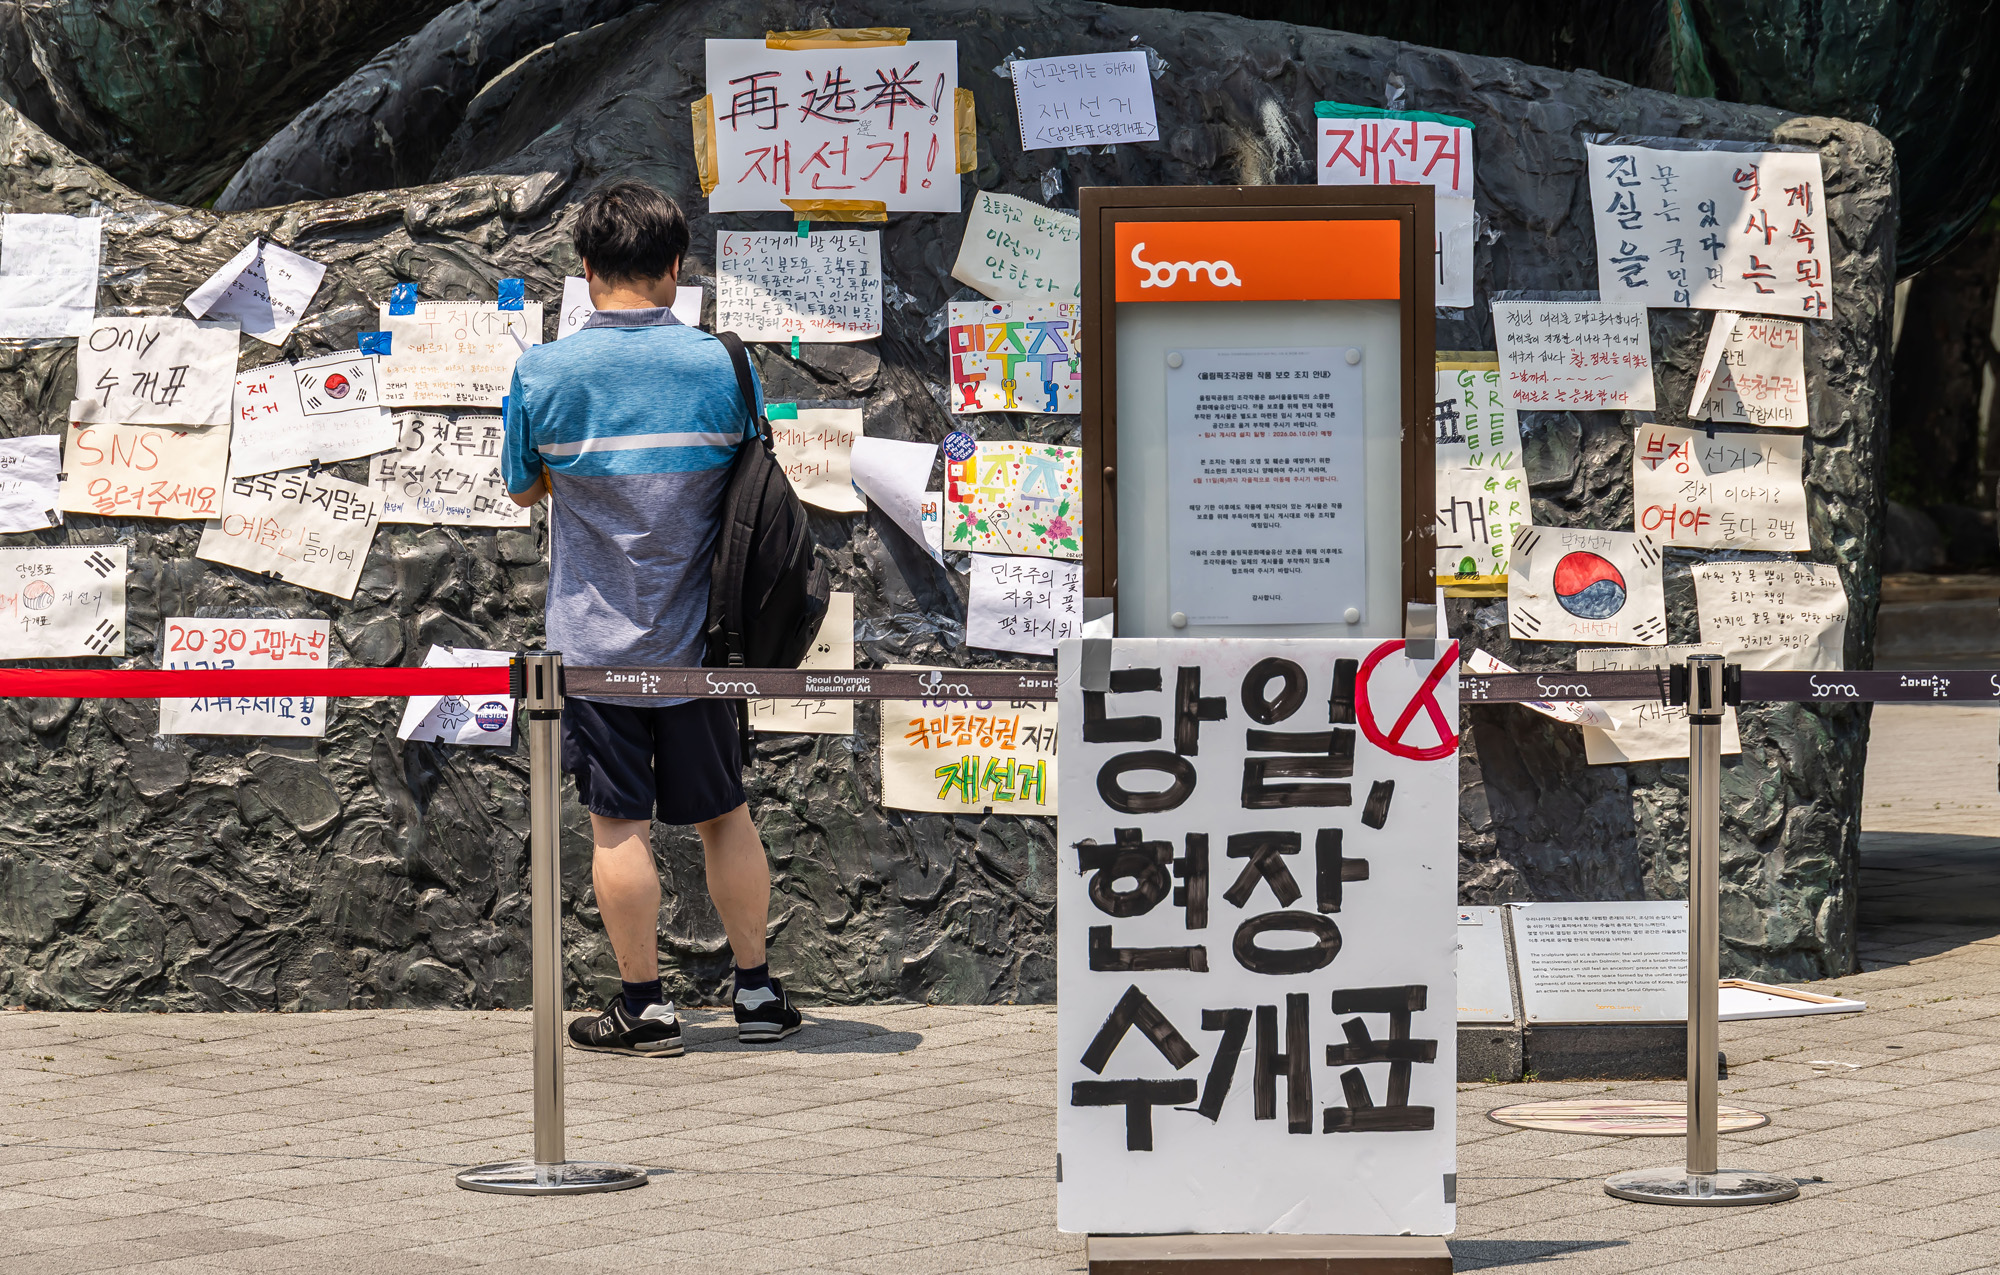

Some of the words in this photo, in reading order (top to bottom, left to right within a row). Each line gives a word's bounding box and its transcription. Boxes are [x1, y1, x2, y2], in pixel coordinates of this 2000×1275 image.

[1024, 62, 1097, 88] 선관위는
[1103, 61, 1136, 77] 해체
[719, 60, 945, 132] 再选举!
[1038, 95, 1133, 119] 재선거
[737, 131, 940, 195] 재선거!
[1325, 121, 1461, 191] 재선거
[1605, 154, 1650, 289] 진실을
[1732, 163, 1778, 295] 역사는
[723, 234, 752, 257] 6.3
[754, 236, 799, 254] 선거에
[810, 235, 869, 254] 발생된
[1697, 198, 1726, 290] 있다면
[1783, 181, 1828, 318] 계속된다
[722, 258, 757, 272] 타인
[822, 256, 873, 276] 중복투표
[1130, 242, 1242, 289] Soma
[1660, 237, 1691, 308] 국민이
[721, 288, 748, 297] 미리
[815, 275, 844, 289] 특정
[720, 298, 757, 310] 가짜
[807, 303, 848, 319] 투표용지
[1506, 309, 1534, 327] 청년
[1539, 311, 1571, 328] 여러분
[782, 317, 808, 335] 전국
[1746, 324, 1799, 351] 재선거
[88, 323, 161, 360] Only
[457, 342, 477, 355] 못한
[949, 320, 1082, 385] 민주주
[1197, 371, 1253, 381] <올림픽조각공원
[1257, 371, 1272, 380] 작품
[1275, 371, 1290, 380] 보호
[1294, 370, 1309, 379] 조치
[1312, 370, 1332, 379] 안내>
[1716, 372, 1802, 403] 소송청구권
[1196, 403, 1249, 411] 문화예술유산입니다.
[1252, 403, 1264, 411] 작품
[1287, 402, 1299, 410] 위해
[1302, 402, 1313, 410] 현재
[1316, 402, 1334, 410] 작품에
[1199, 394, 1234, 402] 올림픽공원의
[1268, 393, 1310, 401] 88서울올림픽의
[240, 402, 280, 422] 선거
[1456, 369, 1484, 468] GREEN
[1483, 369, 1514, 470] GREEN
[1732, 401, 1793, 425] 요구합시다!
[1204, 431, 1216, 439] 임시
[1273, 430, 1318, 438] 2026.06.10.(수)
[1212, 422, 1235, 430] 공간으로
[1273, 421, 1290, 429] 주시기
[817, 428, 856, 451] 아니다
[1209, 458, 1226, 466] 조치는
[1229, 458, 1246, 466] 작품의
[1272, 457, 1290, 465] 훼손을
[1292, 457, 1316, 465] 예방하기
[1640, 432, 1690, 475] 부정
[1704, 445, 1778, 475] 선거가
[375, 458, 479, 498] 부정선거
[947, 453, 1065, 511] 민주주
[1241, 476, 1270, 484] 자율적으로
[1313, 475, 1338, 483] 바랍니다.
[87, 477, 217, 516] 올려주세요
[1678, 479, 1713, 504] 정치
[1724, 486, 1781, 504] 이야기?
[1483, 476, 1508, 576] GREEN
[1640, 502, 1713, 540] 여야
[1719, 511, 1758, 541] 둘다
[1766, 517, 1796, 540] 공범
[1561, 532, 1613, 551] 부정선거
[990, 562, 1055, 589] 민주주의
[1062, 573, 1080, 593] 꽃
[1257, 567, 1275, 575] 주시기
[1702, 571, 1725, 584] 사원
[1793, 571, 1817, 587] 망한
[61, 591, 103, 618] 재선거
[1002, 588, 1052, 610] 자유의
[1061, 594, 1077, 614] 꽃
[1252, 594, 1282, 602] 감사합니다.
[1730, 590, 1756, 604] 회장
[1763, 590, 1786, 605] 책임
[20, 614, 52, 633] 수개표
[997, 614, 1083, 640] 평화시위!
[1568, 621, 1619, 637] 재선거
[1712, 615, 1747, 629] 정치인
[1800, 611, 1822, 625] 망한
[1825, 612, 1847, 624] 나라
[1738, 634, 1774, 649] 정치인
[1778, 633, 1810, 650] 책임?
[705, 672, 761, 695] Soma
[805, 675, 832, 684] Seoul
[833, 675, 870, 685] Olympic
[805, 684, 844, 692] Museum
[845, 684, 855, 692] of
[857, 684, 872, 692] Art
[1536, 675, 1592, 698] Soma
[1809, 674, 1860, 697] Soma
[904, 714, 1020, 751] 국민참정권
[934, 754, 1047, 807] 재선거
[1071, 826, 1370, 975] 현장
[1070, 983, 1438, 1152] 수개표
